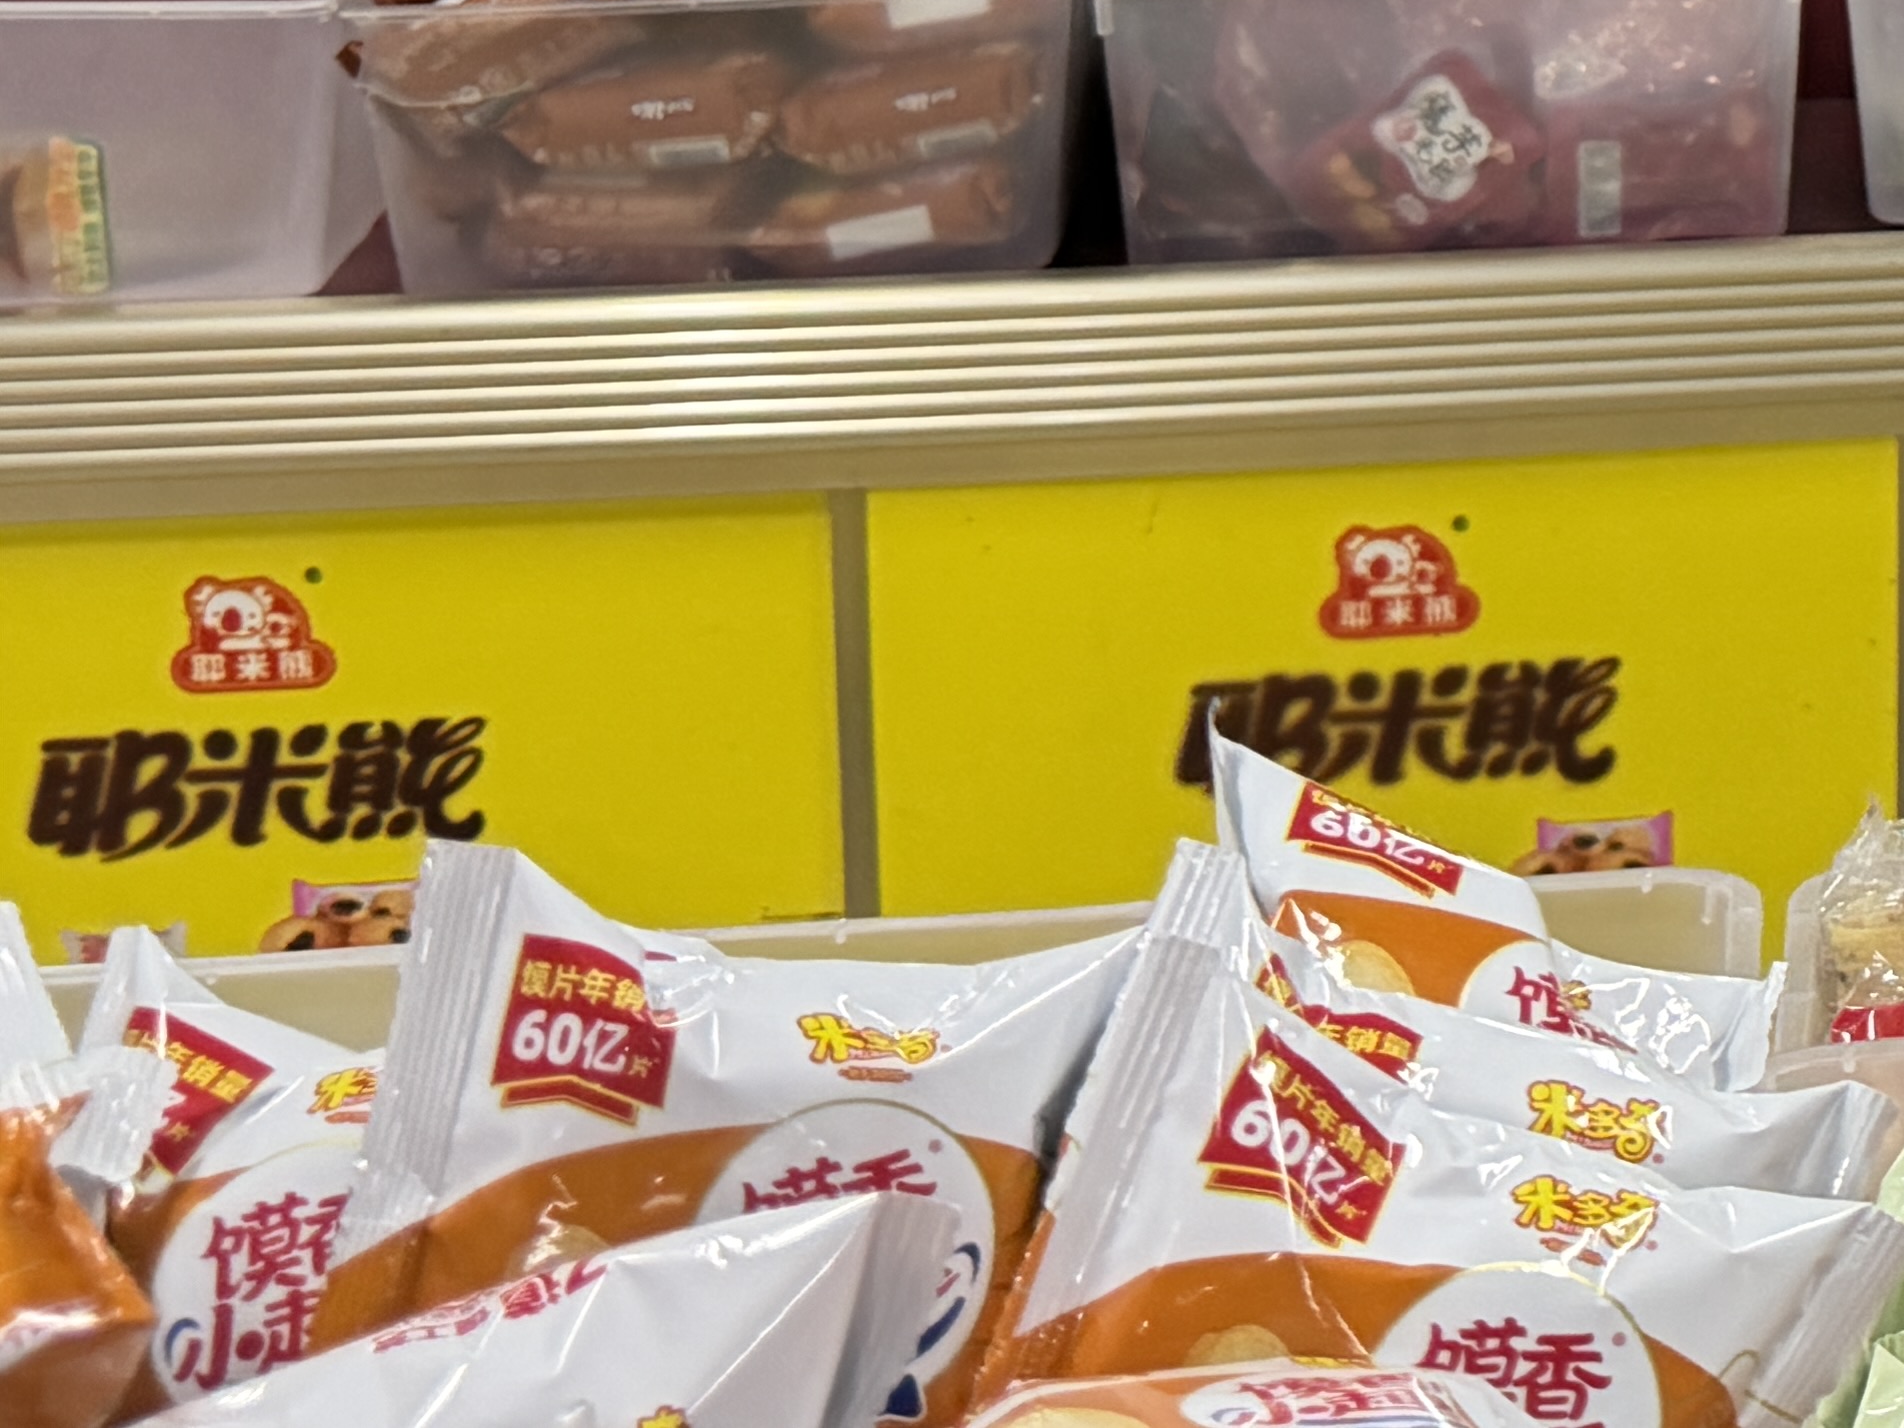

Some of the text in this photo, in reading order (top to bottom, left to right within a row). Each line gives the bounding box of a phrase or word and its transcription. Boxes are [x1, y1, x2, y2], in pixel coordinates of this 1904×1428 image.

[190, 650, 317, 684] 耶米熊
[1175, 654, 1622, 792] 耶米熊
[26, 716, 488, 863] 耶米熊
[1528, 1080, 1663, 1162] 米多奇
[1511, 1174, 1659, 1250] 米多奇
